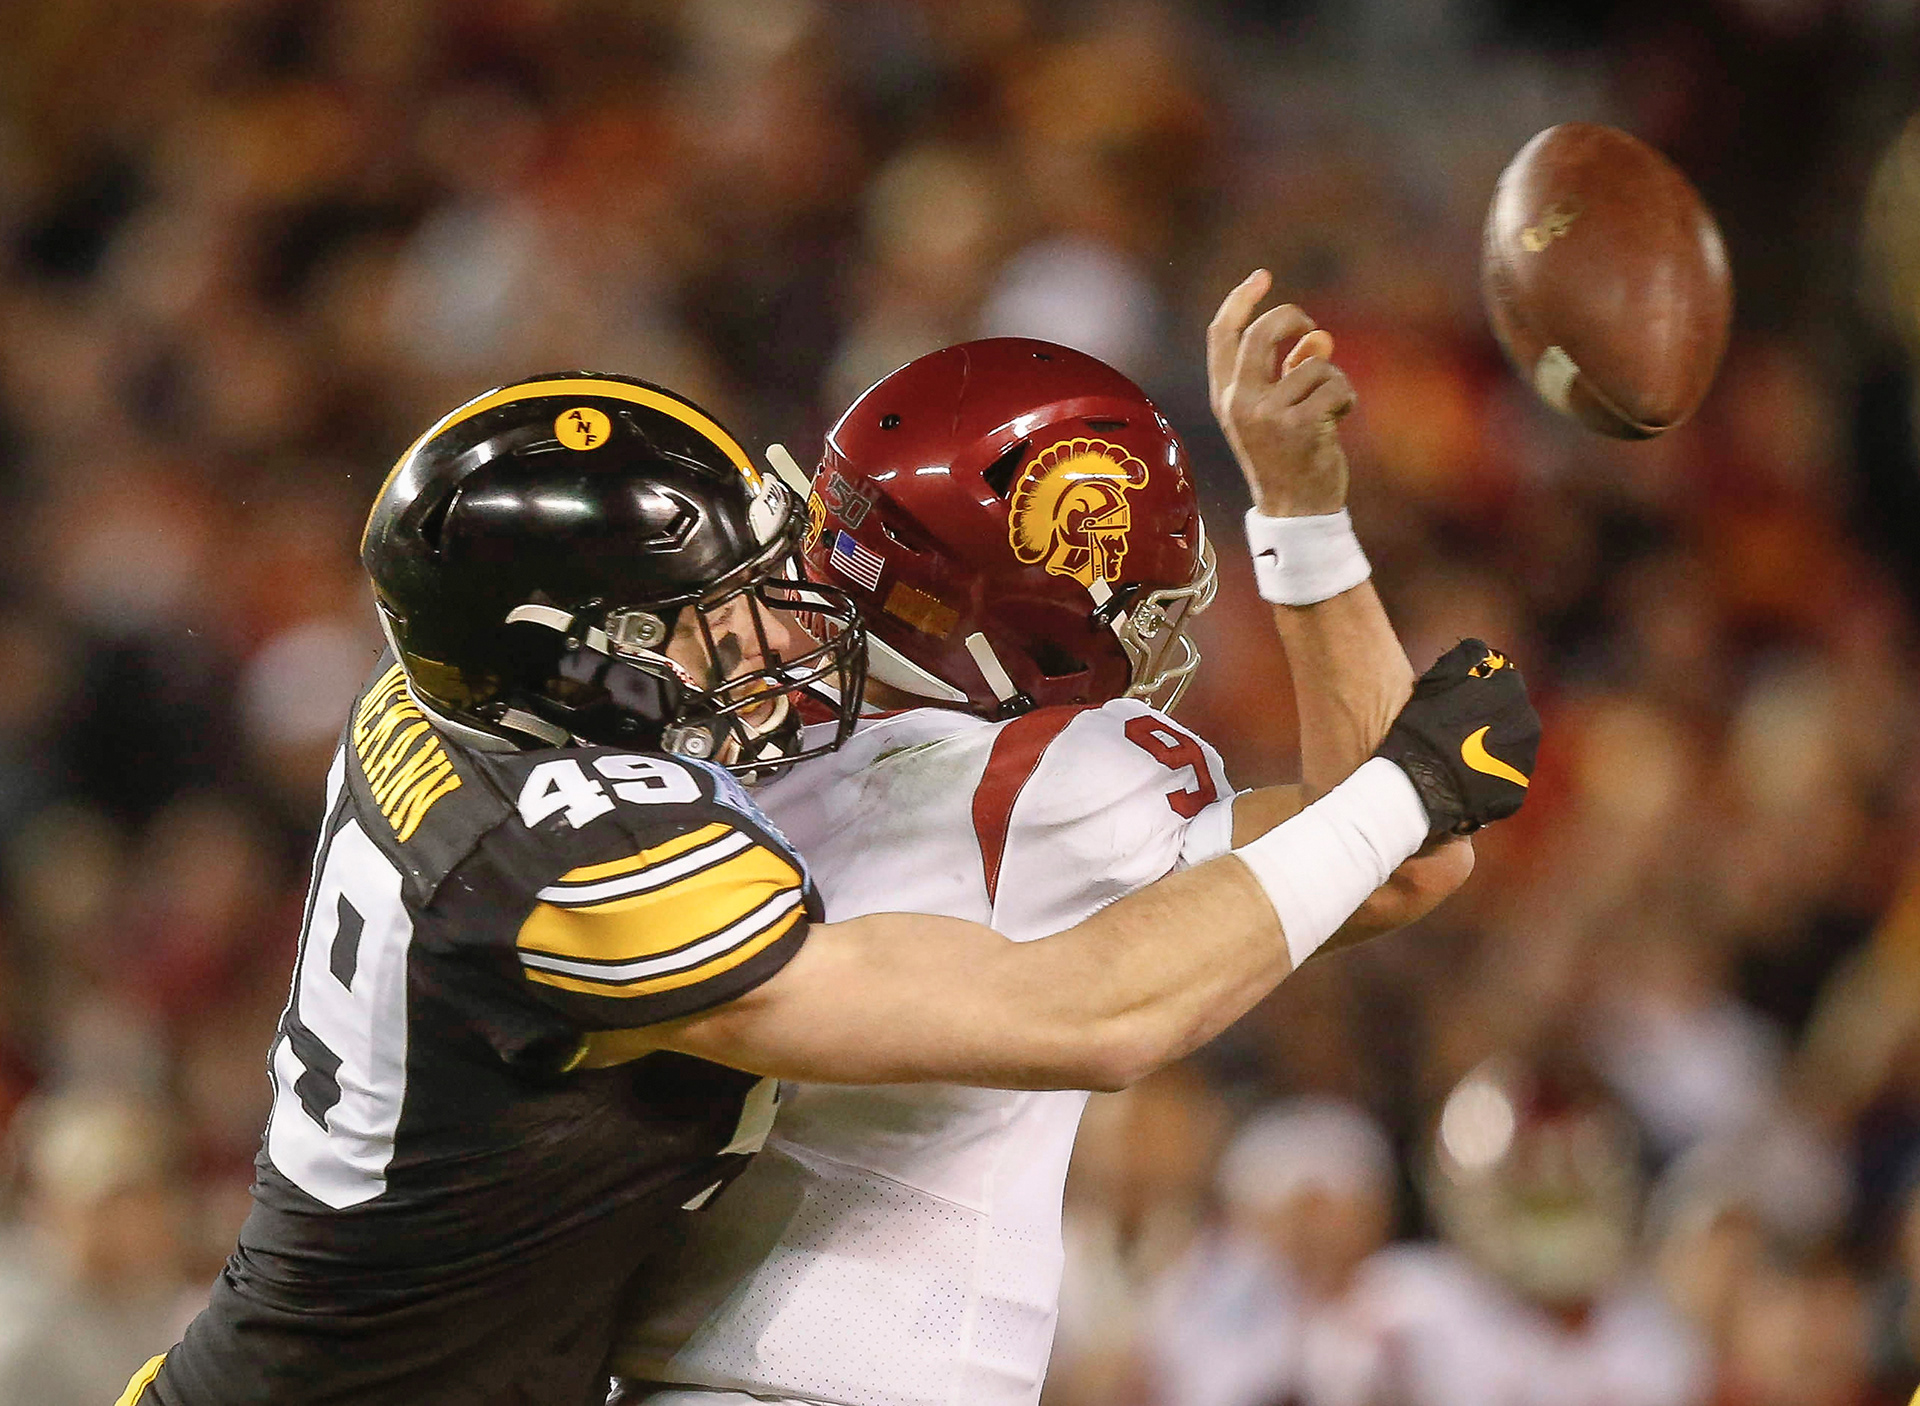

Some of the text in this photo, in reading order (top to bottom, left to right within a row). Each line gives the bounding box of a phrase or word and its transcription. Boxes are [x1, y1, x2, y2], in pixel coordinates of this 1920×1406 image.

[567, 410, 598, 447] ANF
[515, 753, 703, 830] 49
[1123, 713, 1219, 820] 9
[265, 742, 415, 1211] 9
